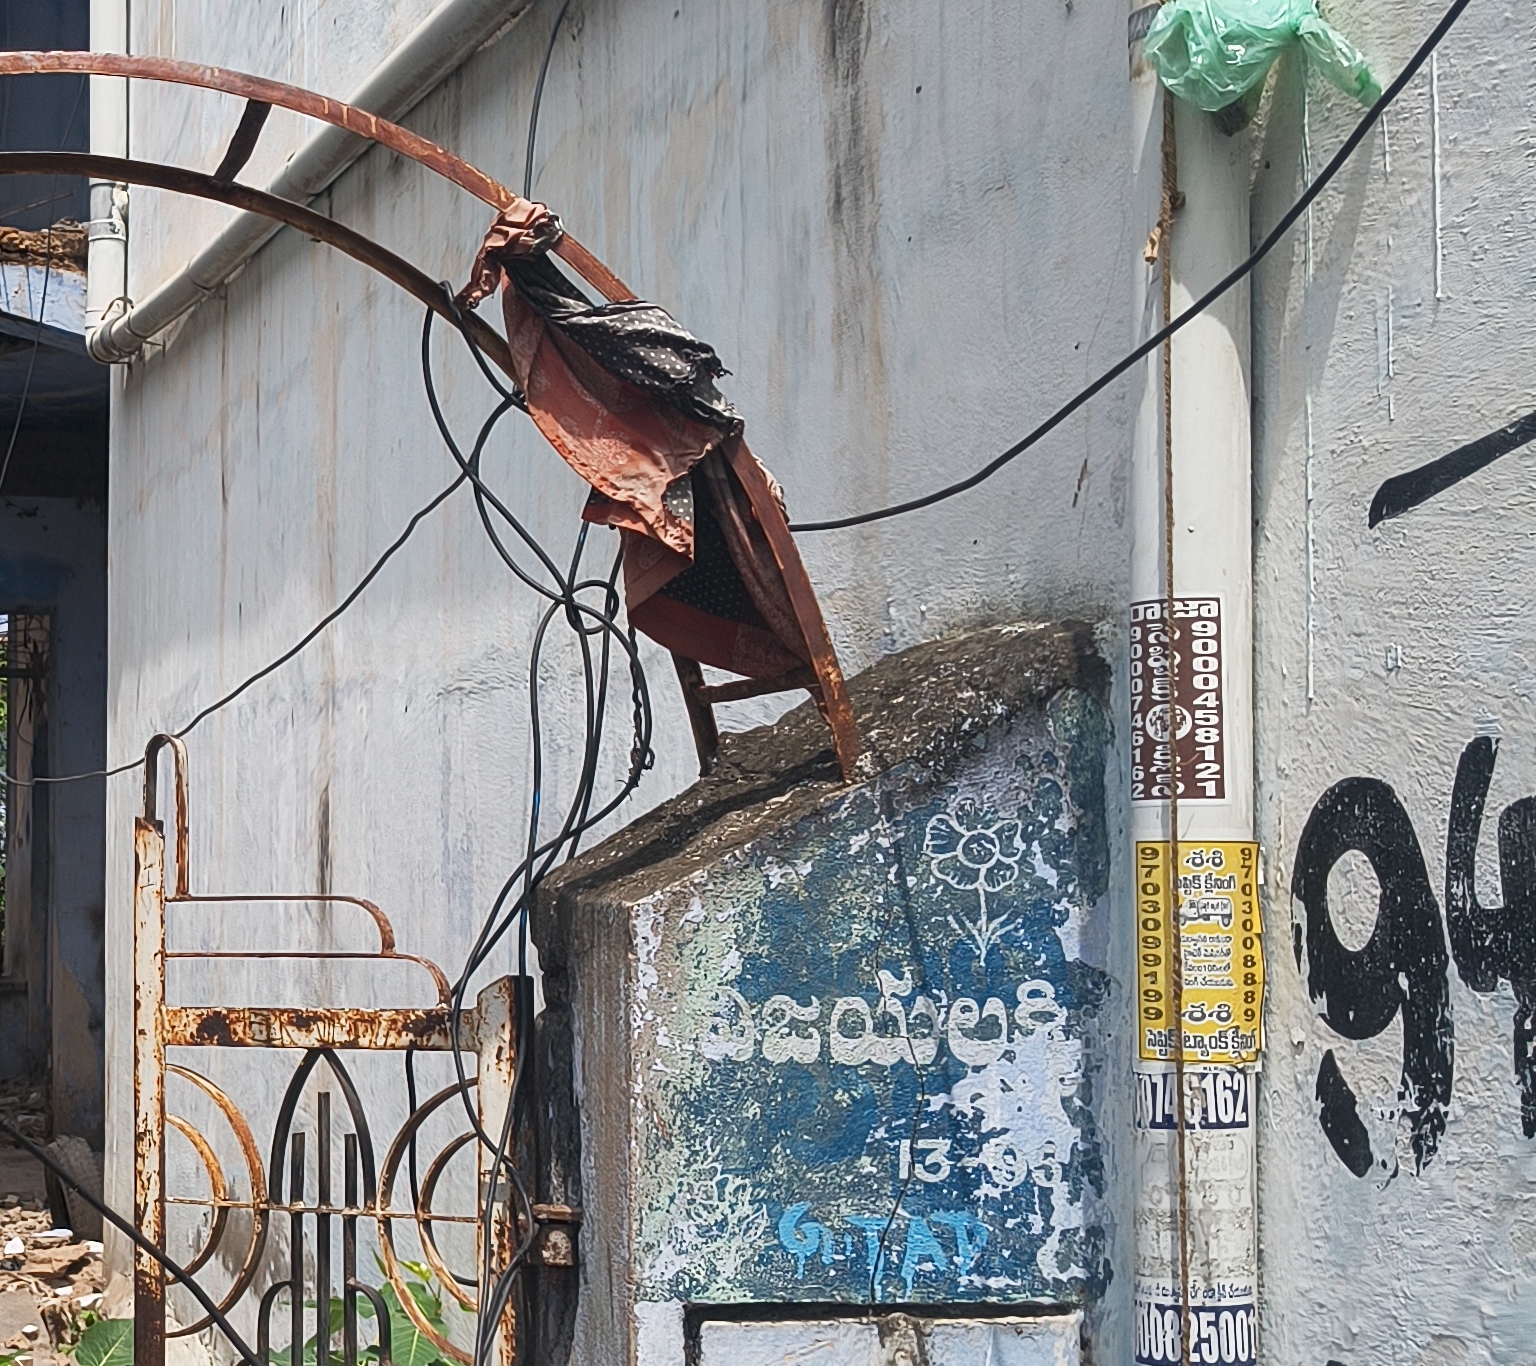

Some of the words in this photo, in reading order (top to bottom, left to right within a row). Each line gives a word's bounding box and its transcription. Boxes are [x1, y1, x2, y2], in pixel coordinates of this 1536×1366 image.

[1129, 626, 1145, 799] 9000746162
[1190, 620, 1221, 797] 9000458121
[1140, 846, 1164, 1022] 9703099199
[1240, 847, 1257, 1023] 9703008889
